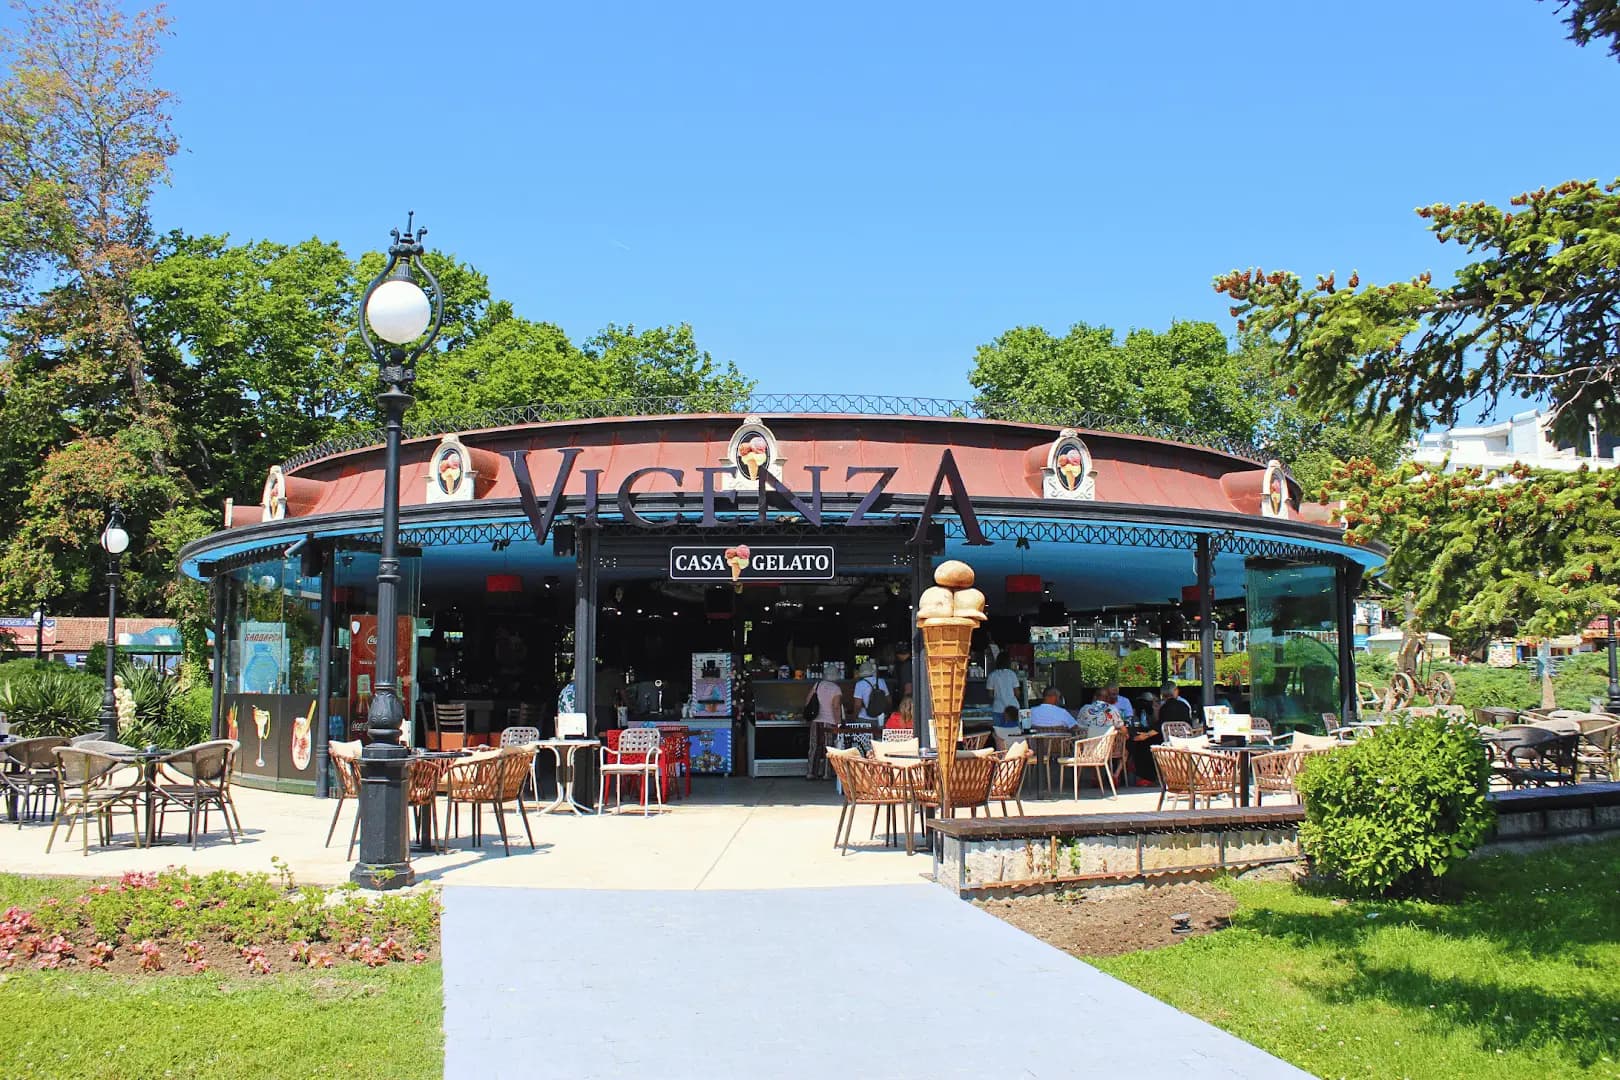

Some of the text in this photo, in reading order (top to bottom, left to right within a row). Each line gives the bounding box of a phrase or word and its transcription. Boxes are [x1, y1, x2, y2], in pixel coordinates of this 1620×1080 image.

[500, 448, 995, 546] VICENZA
[675, 554, 830, 571] CASA GELATO
